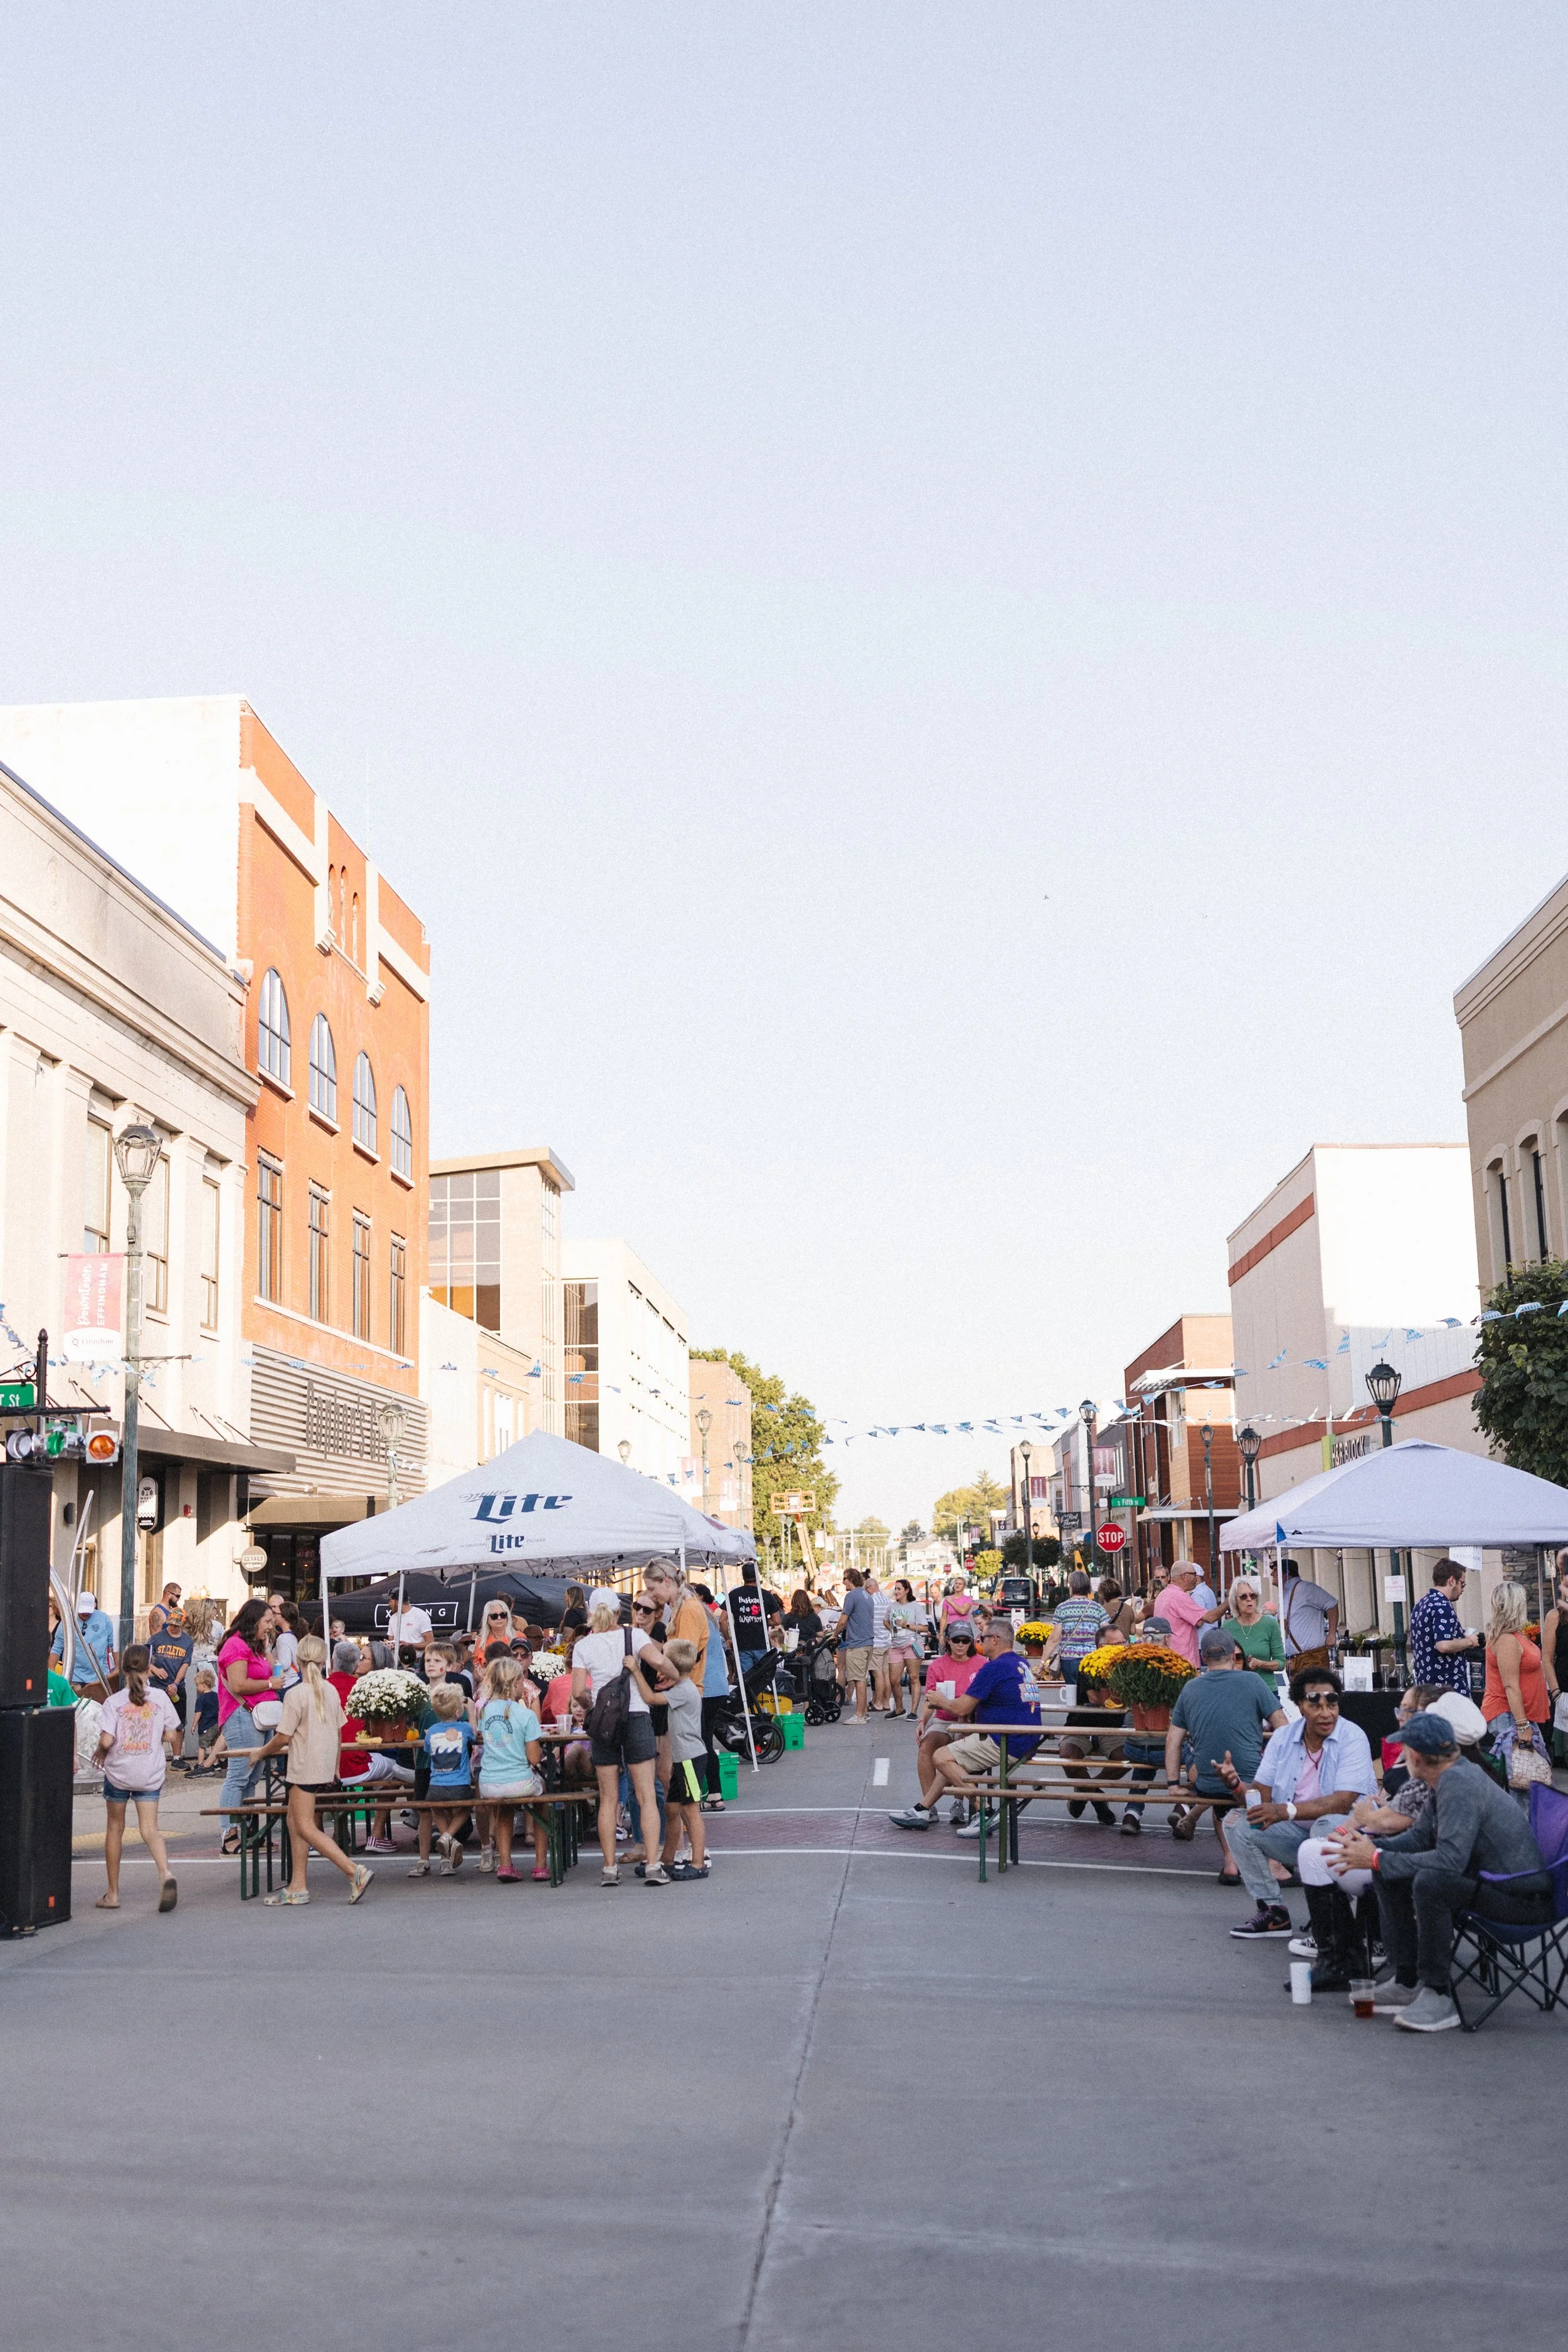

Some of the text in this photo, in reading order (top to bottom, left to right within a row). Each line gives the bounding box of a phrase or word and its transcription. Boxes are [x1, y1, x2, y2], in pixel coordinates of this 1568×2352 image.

[77, 1263, 92, 1326] Downtown
[97, 1263, 108, 1325] EFFINGHAM
[9, 1394, 20, 1407] St
[1332, 1435, 1365, 1468] H&R BLOCK
[470, 1493, 573, 1524] Lite
[1121, 1498, 1134, 1506] Fifth
[1098, 1531, 1123, 1544] STOP
[489, 1535, 524, 1554] Lite
[738, 1596, 761, 1604] Husban
[385, 1608, 446, 1618] XNG
[166, 1645, 186, 1657] CLETUS
